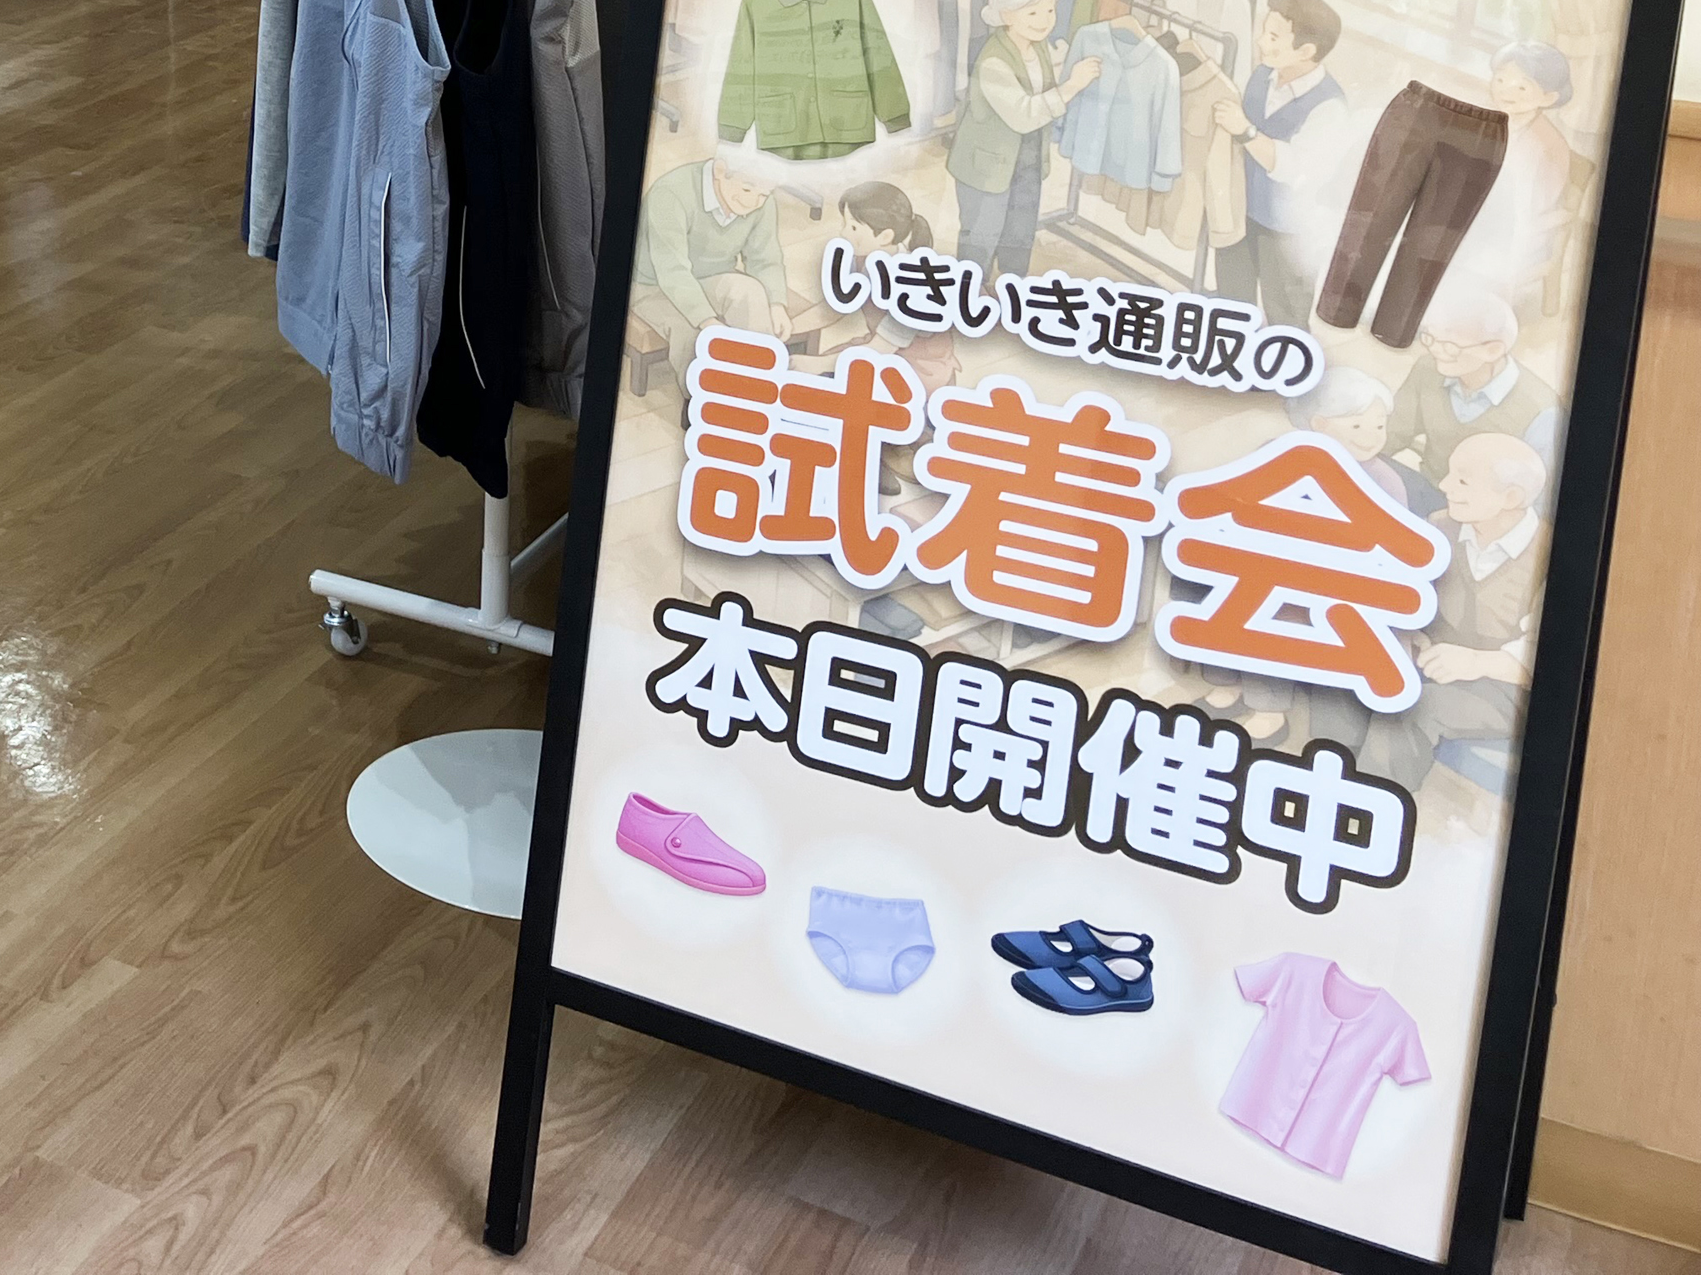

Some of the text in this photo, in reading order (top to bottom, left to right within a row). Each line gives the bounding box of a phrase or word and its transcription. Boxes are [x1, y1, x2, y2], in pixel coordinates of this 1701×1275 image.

[829, 243, 1316, 391] いきいき通販の
[688, 336, 1437, 701] 試着会
[651, 596, 1411, 910] 本日開催中
